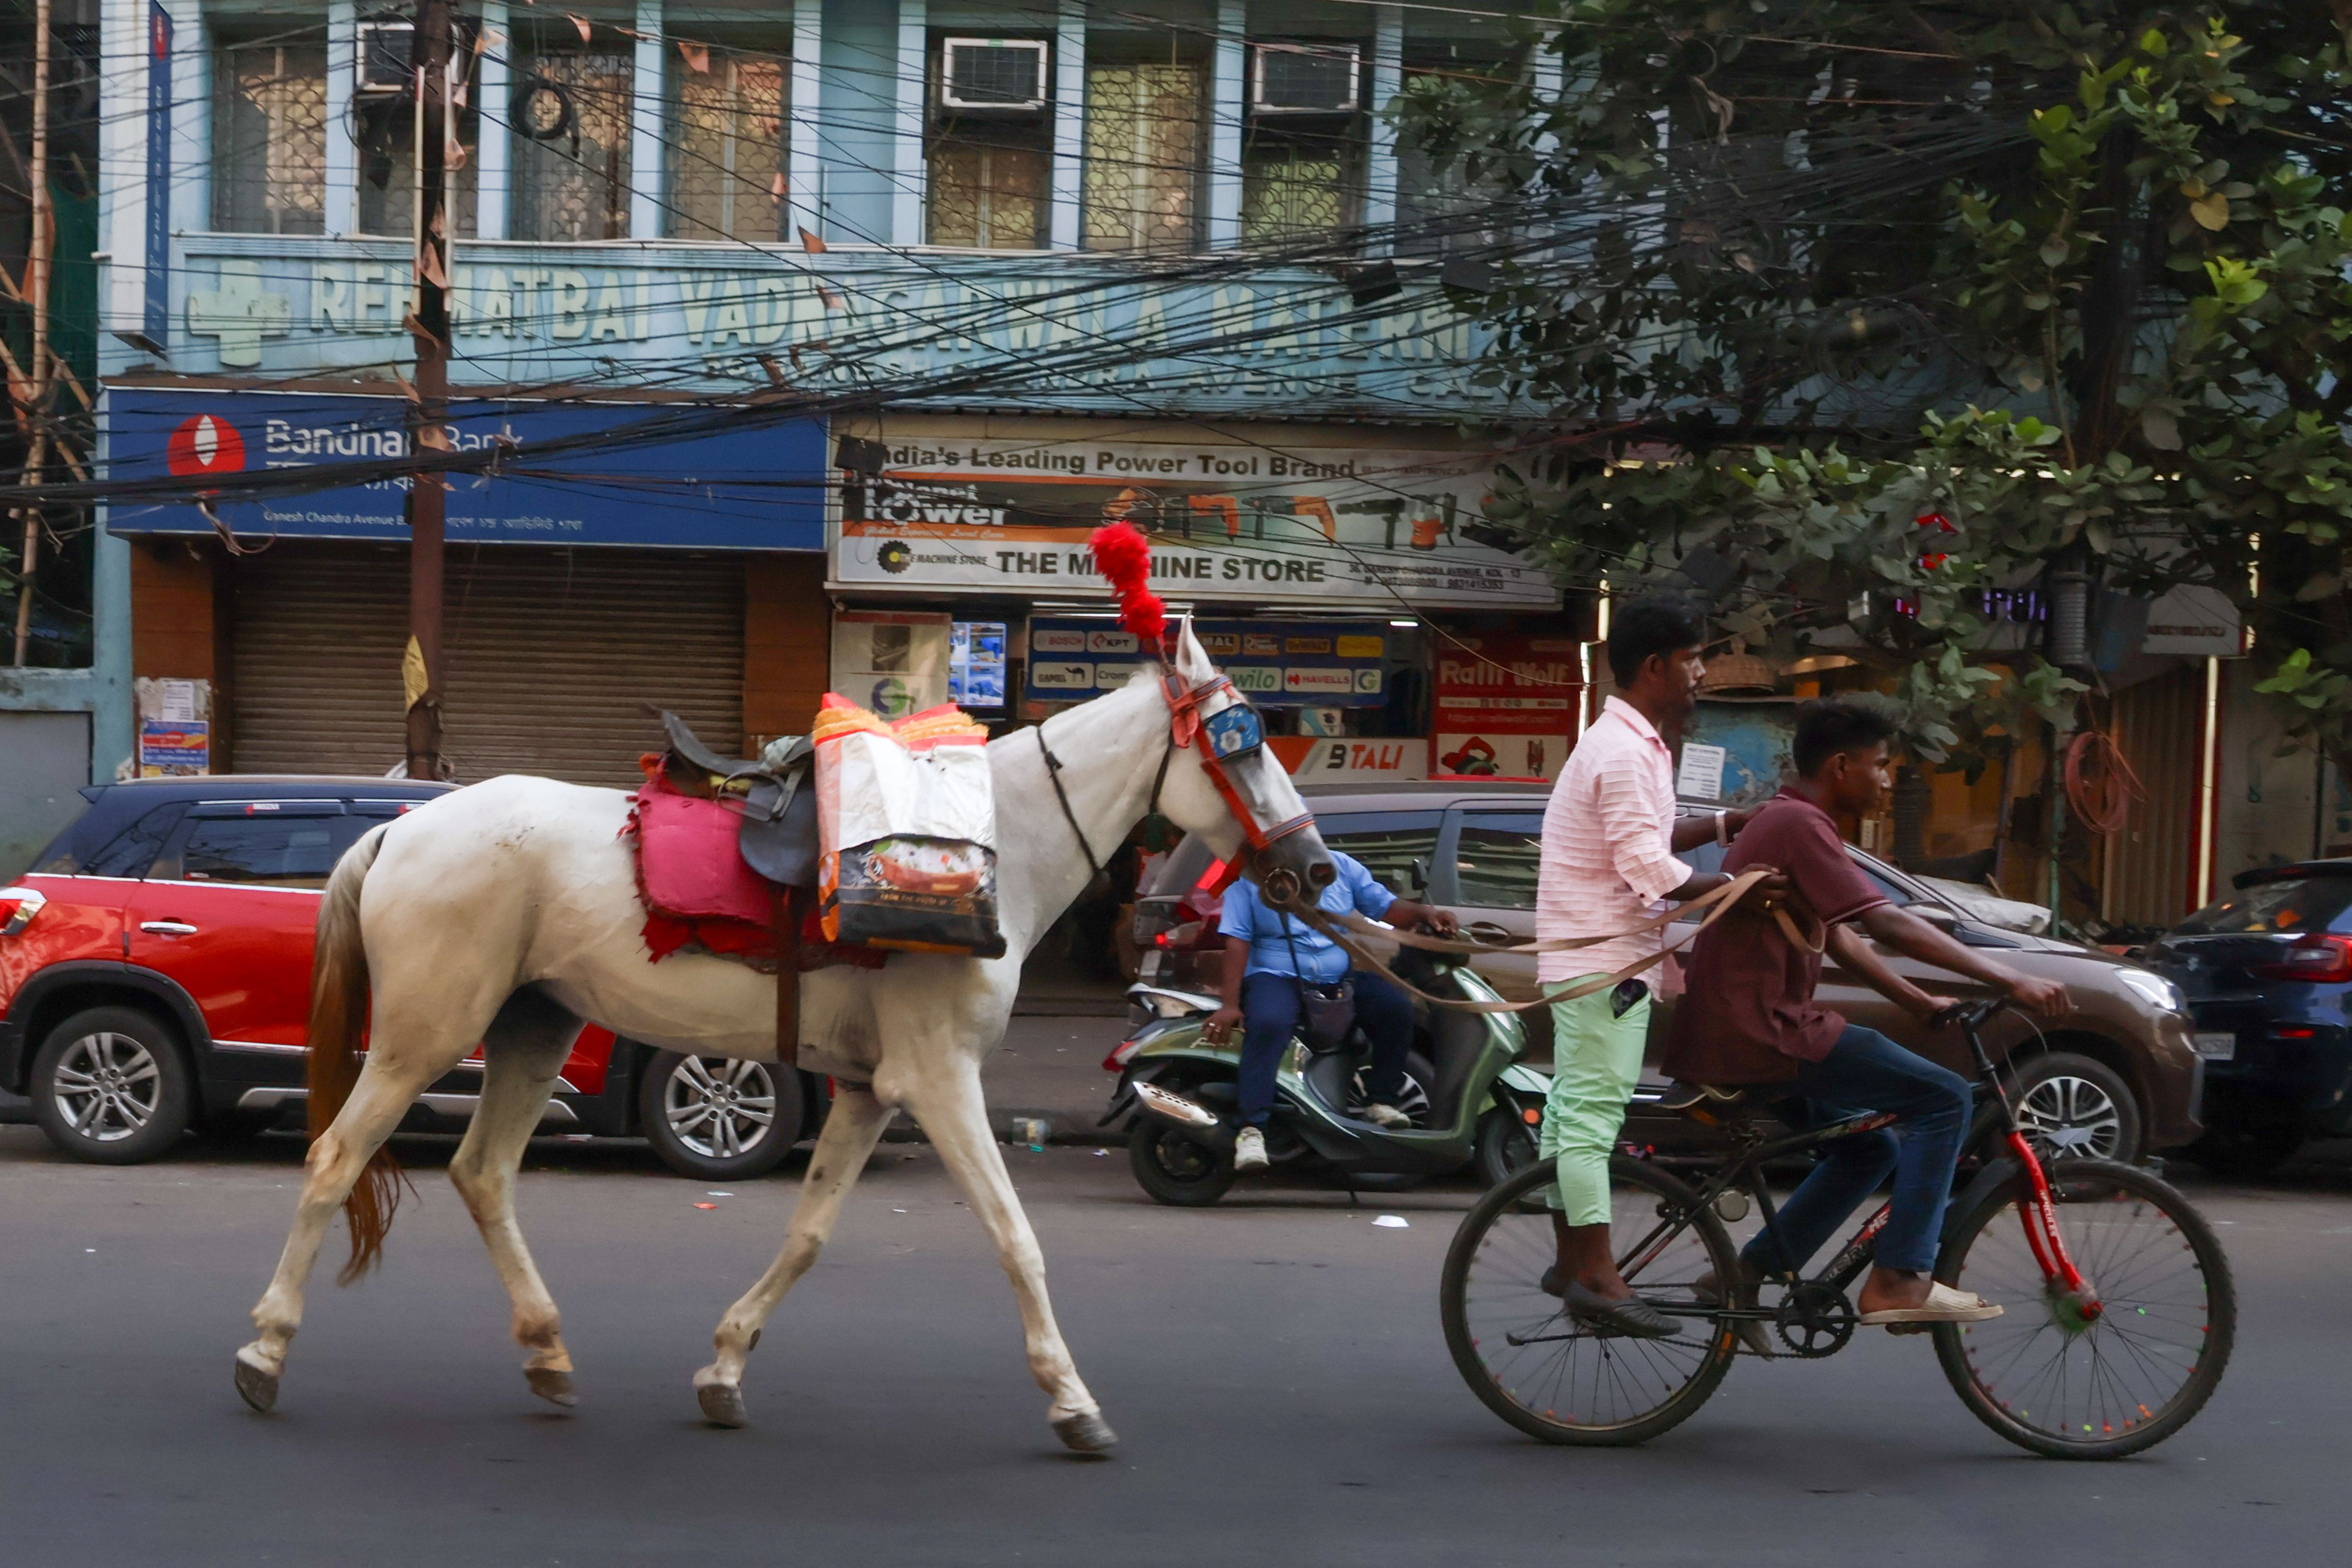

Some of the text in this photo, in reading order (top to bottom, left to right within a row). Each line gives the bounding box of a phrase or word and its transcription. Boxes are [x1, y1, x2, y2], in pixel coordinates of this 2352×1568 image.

[883, 445, 960, 467] ndia's
[971, 448, 1085, 475] Leading
[1096, 451, 1188, 474] Power
[1197, 454, 1258, 476] Tool
[1269, 456, 1355, 478] Brand
[996, 551, 1325, 583] THE MINE STORE
[1107, 639, 1129, 648] KPT
[1231, 669, 1275, 689] wilo
[1302, 675, 1350, 684] HAVELLS
